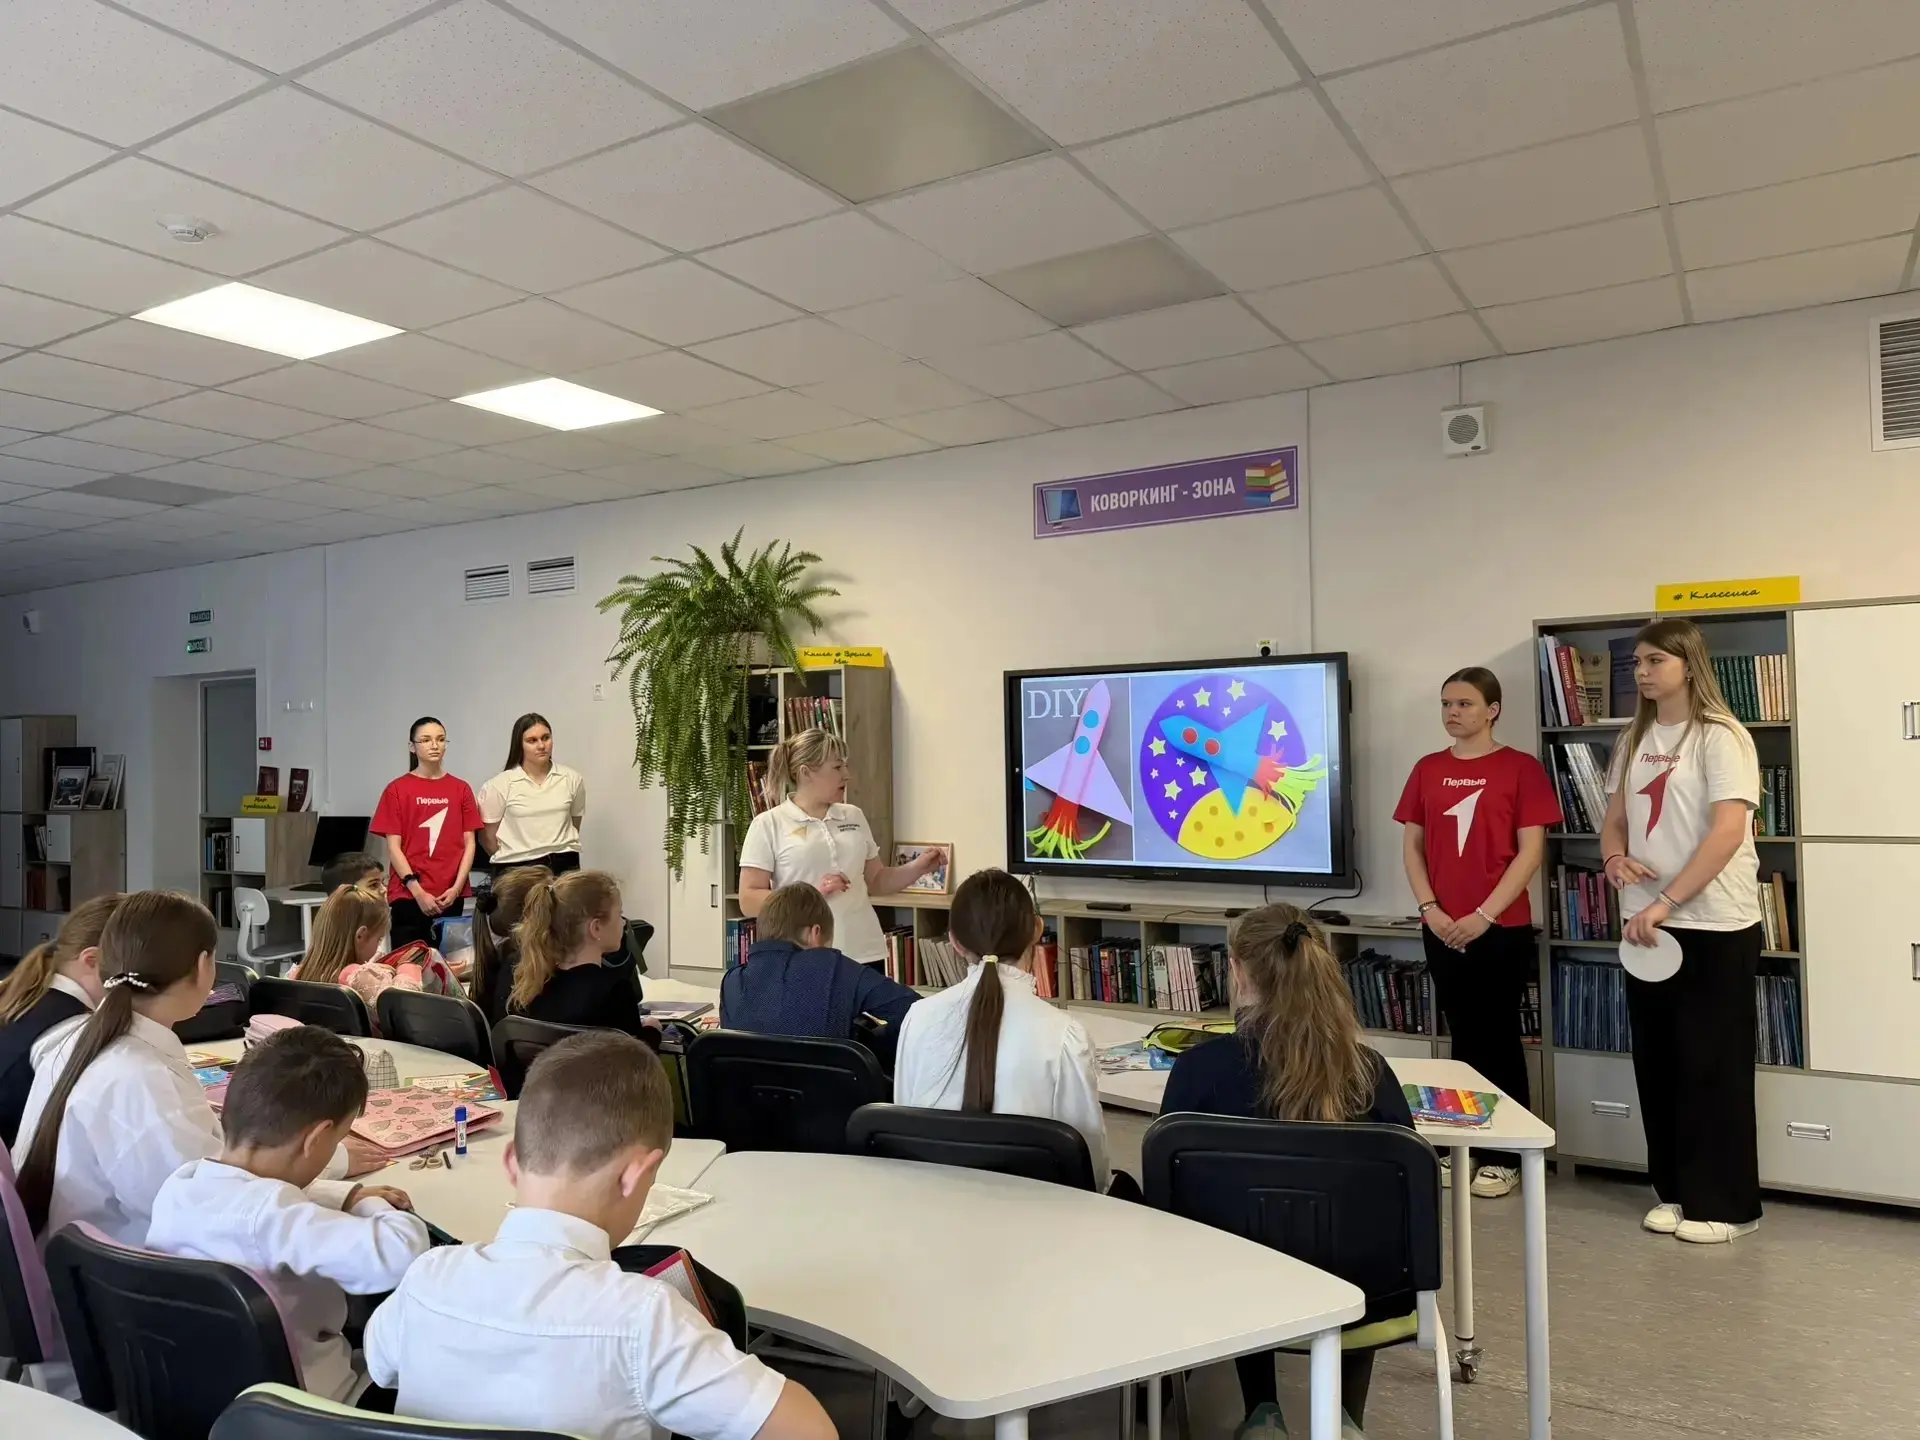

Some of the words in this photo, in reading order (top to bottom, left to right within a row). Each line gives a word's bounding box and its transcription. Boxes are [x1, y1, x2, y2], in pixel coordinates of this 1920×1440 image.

[1091, 484, 1179, 513] КОВОРКИНГ
[1192, 476, 1236, 499] ЗОНА
[1689, 588, 1760, 600] Классика
[844, 650, 873, 658] Время
[1027, 688, 1088, 719] DIY
[1640, 753, 1681, 765] Первые
[1442, 777, 1487, 788] Первые
[416, 796, 449, 806] Первые
